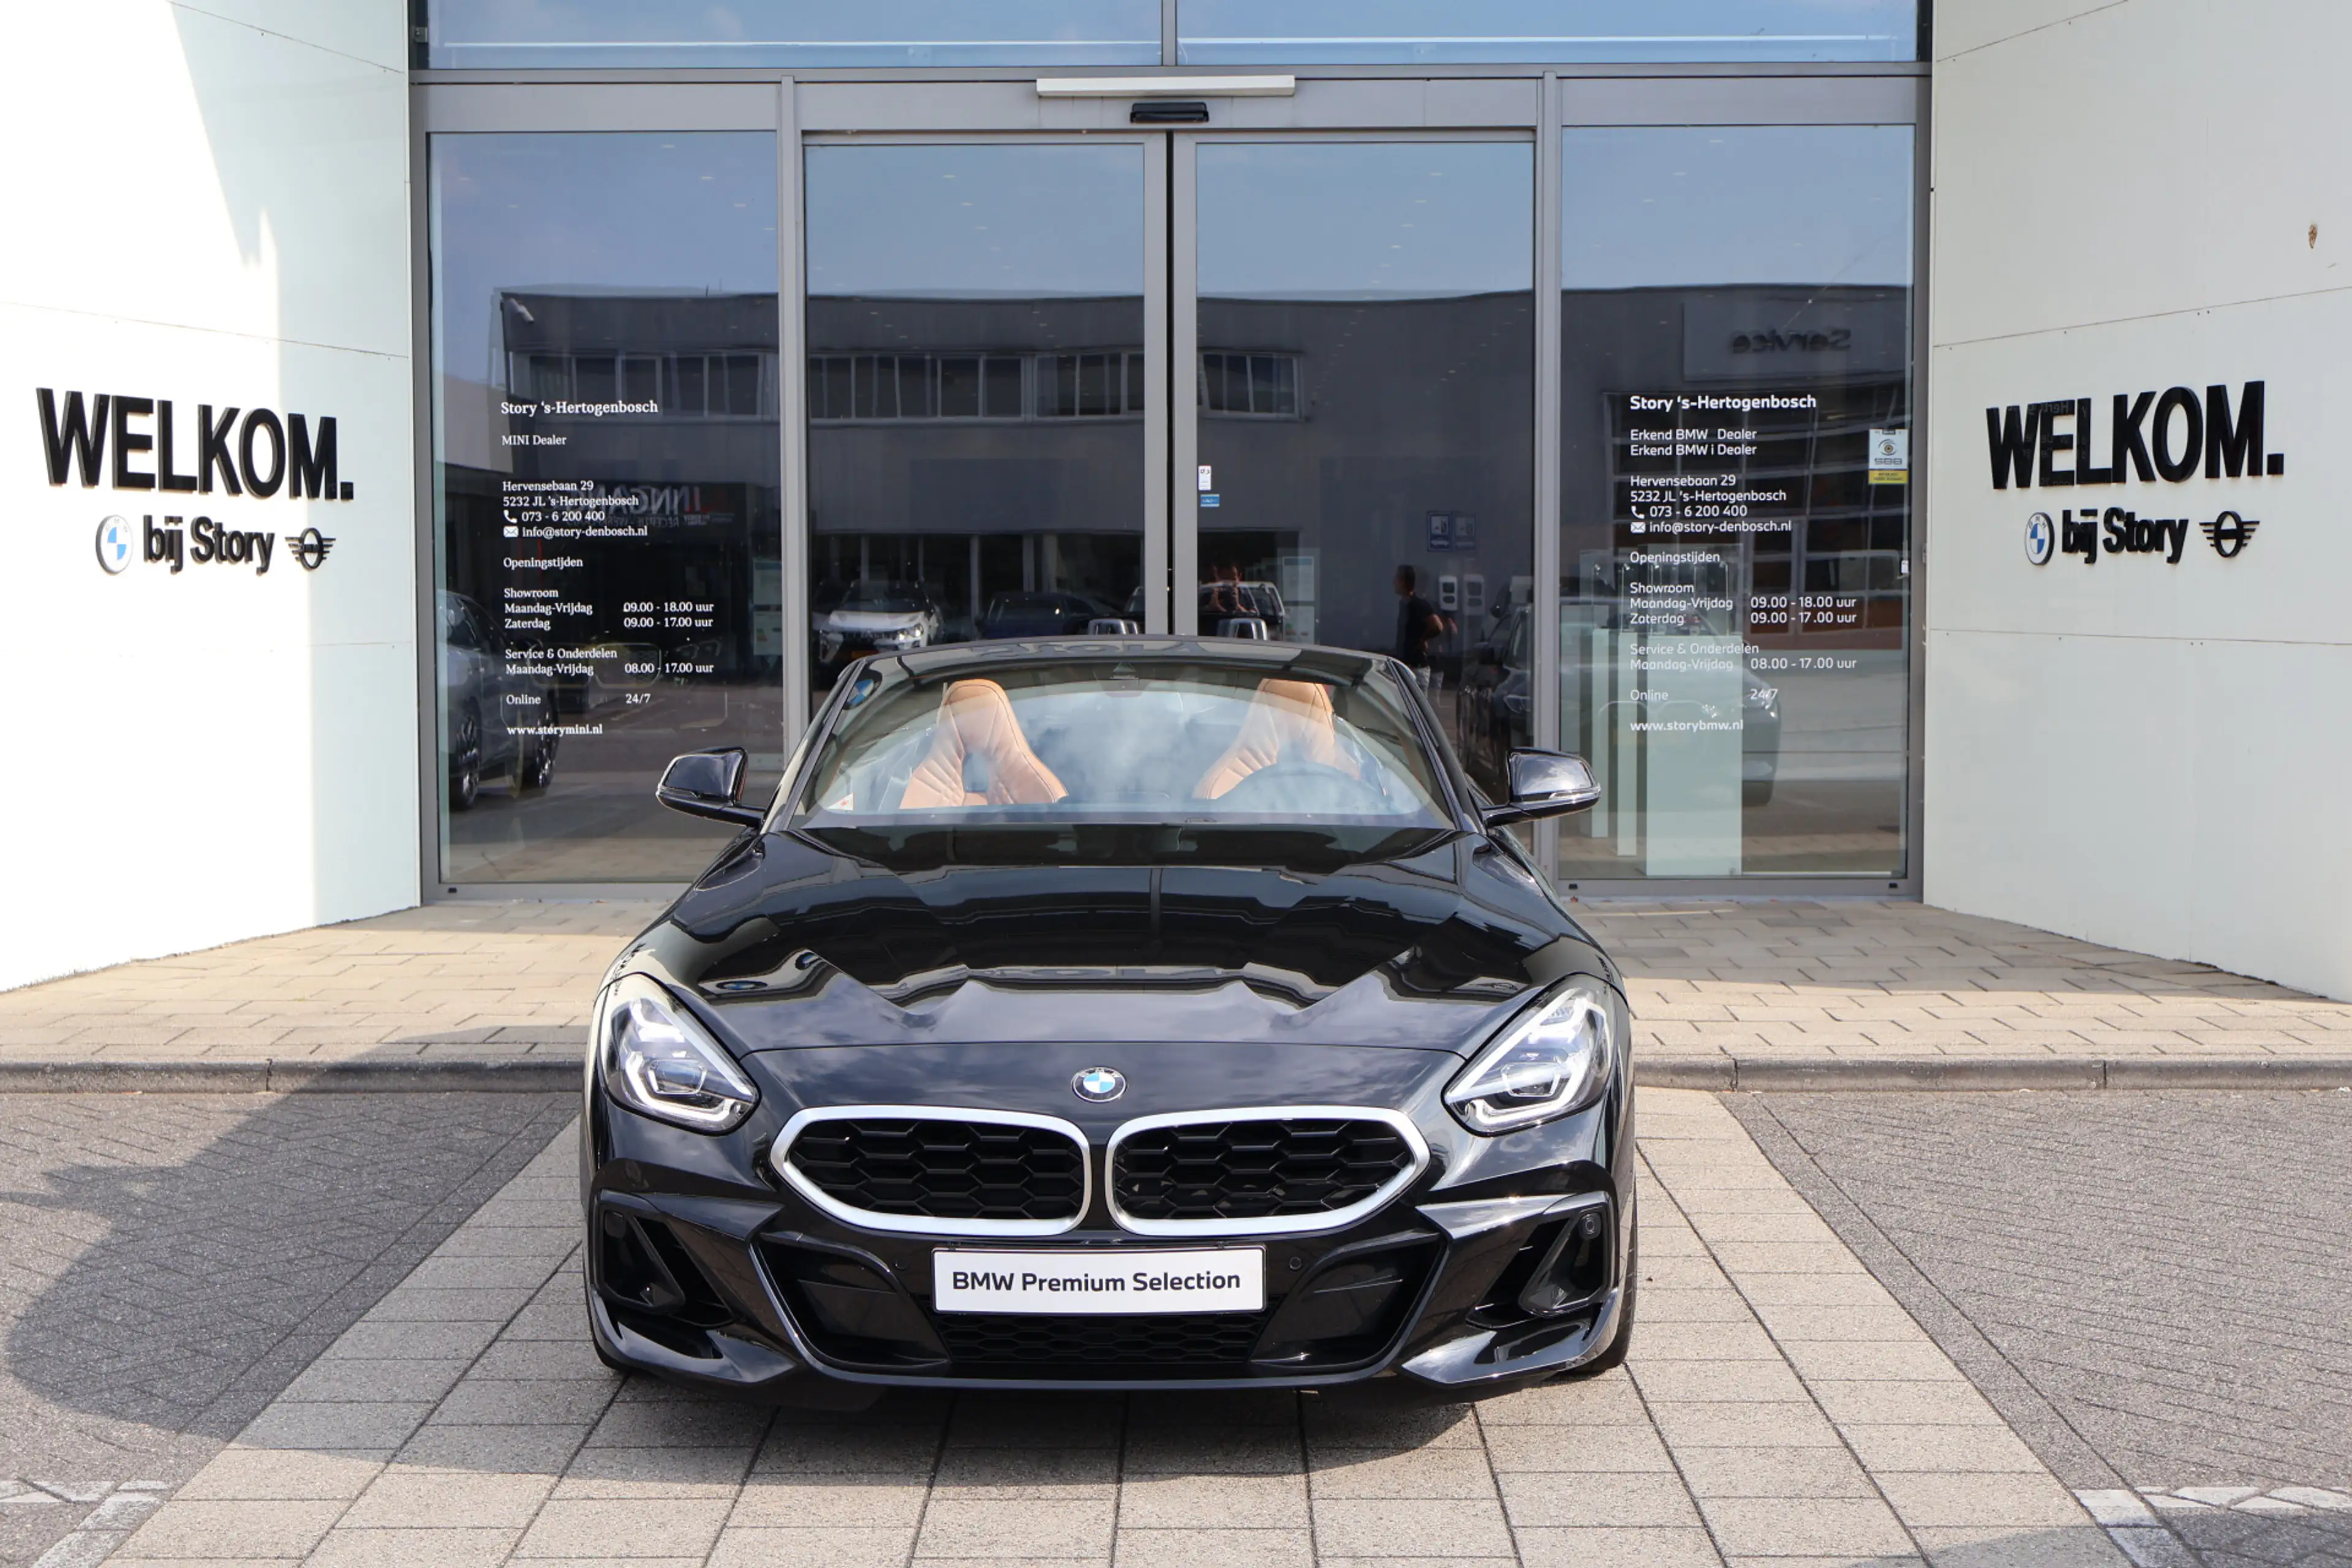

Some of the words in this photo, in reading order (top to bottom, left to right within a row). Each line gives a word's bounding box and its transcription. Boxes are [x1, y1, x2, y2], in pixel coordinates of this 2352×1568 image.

[501, 402, 538, 417] Story
[1630, 396, 1673, 413] Story
[502, 435, 529, 446] MINI
[533, 435, 567, 446] Dealer
[1630, 429, 1672, 441] Erkend
[1676, 429, 1708, 440] BMW
[1717, 429, 1757, 440] Dealer
[1986, 380, 2285, 489] WELKOM.
[36, 387, 354, 501] WELKOM.
[1630, 444, 1672, 456] Erkend
[1676, 444, 1708, 456] BMW
[1711, 444, 1715, 455] i
[1717, 444, 1757, 456] Dealer
[503, 480, 578, 492] Hervensebaan
[579, 480, 594, 491] 29
[1630, 475, 1718, 487] Hervensebaan
[1720, 475, 1736, 486] 29
[503, 496, 530, 507] 5232
[532, 496, 546, 507] JL
[1630, 491, 1660, 502] 5232
[1662, 491, 1676, 502] JL
[521, 511, 543, 522] 073
[551, 511, 559, 522] 6
[562, 510, 582, 522] 200
[584, 510, 606, 521] 400
[1649, 506, 1672, 518] 073
[1684, 505, 1693, 518] 6
[1695, 505, 1720, 518] 200
[1722, 505, 1748, 517] 400
[522, 526, 649, 540] info@story-denbosch.nl
[1649, 519, 1792, 536] info@story-denbosch.nl
[2062, 508, 2098, 565] bij
[2103, 507, 2189, 565] Story
[143, 514, 183, 575] bij
[190, 515, 276, 576] Story
[503, 557, 584, 570] Openingstijden
[1630, 551, 1720, 565] Openingstijden
[503, 587, 559, 598] Showroom
[1630, 582, 1694, 594] Showroom
[504, 602, 593, 616] Maandag-Vrijdag
[623, 601, 654, 613] 09.00
[663, 601, 693, 612] 18.00
[695, 603, 714, 612] uur
[1630, 598, 1734, 611] Maandag-Vrijdag
[1751, 597, 1787, 609] 09.00
[1799, 596, 1833, 609] 18.00
[1836, 598, 1857, 608] uur
[504, 618, 551, 631] Zaterdag
[624, 617, 654, 628] 09.00
[664, 617, 693, 628] 17.00
[695, 619, 714, 627] uur
[1630, 613, 1685, 626] Zaterdag
[1751, 612, 1787, 624] 09.00
[1800, 612, 1833, 624] 17.00
[1837, 614, 1857, 624] uur
[505, 648, 545, 660] Service
[547, 648, 555, 659] &
[557, 647, 618, 659] Onderdelen
[1630, 643, 1674, 655] Service
[1676, 643, 1687, 655] &
[1690, 643, 1760, 655] Onderdelen
[505, 663, 594, 676] Maandag-Vrijdag
[624, 663, 655, 674] 08.00
[664, 662, 693, 673] 17.00
[695, 664, 714, 673] uur
[1630, 658, 1734, 672] Maandag-Vrijdag
[1751, 657, 1787, 669] 08.00
[1800, 657, 1834, 669] 17.00
[1837, 659, 1857, 669] uur
[506, 694, 541, 705] Online
[625, 693, 651, 705] 24/7
[1630, 689, 1668, 701] Online
[1750, 688, 1779, 701] 24/7
[507, 723, 603, 737] www.storymini.nl
[1630, 720, 1744, 733] www.storybmw.nl
[952, 1271, 1014, 1291] BMW
[1022, 1272, 1126, 1292] Premium
[1132, 1270, 1241, 1291] Selection
